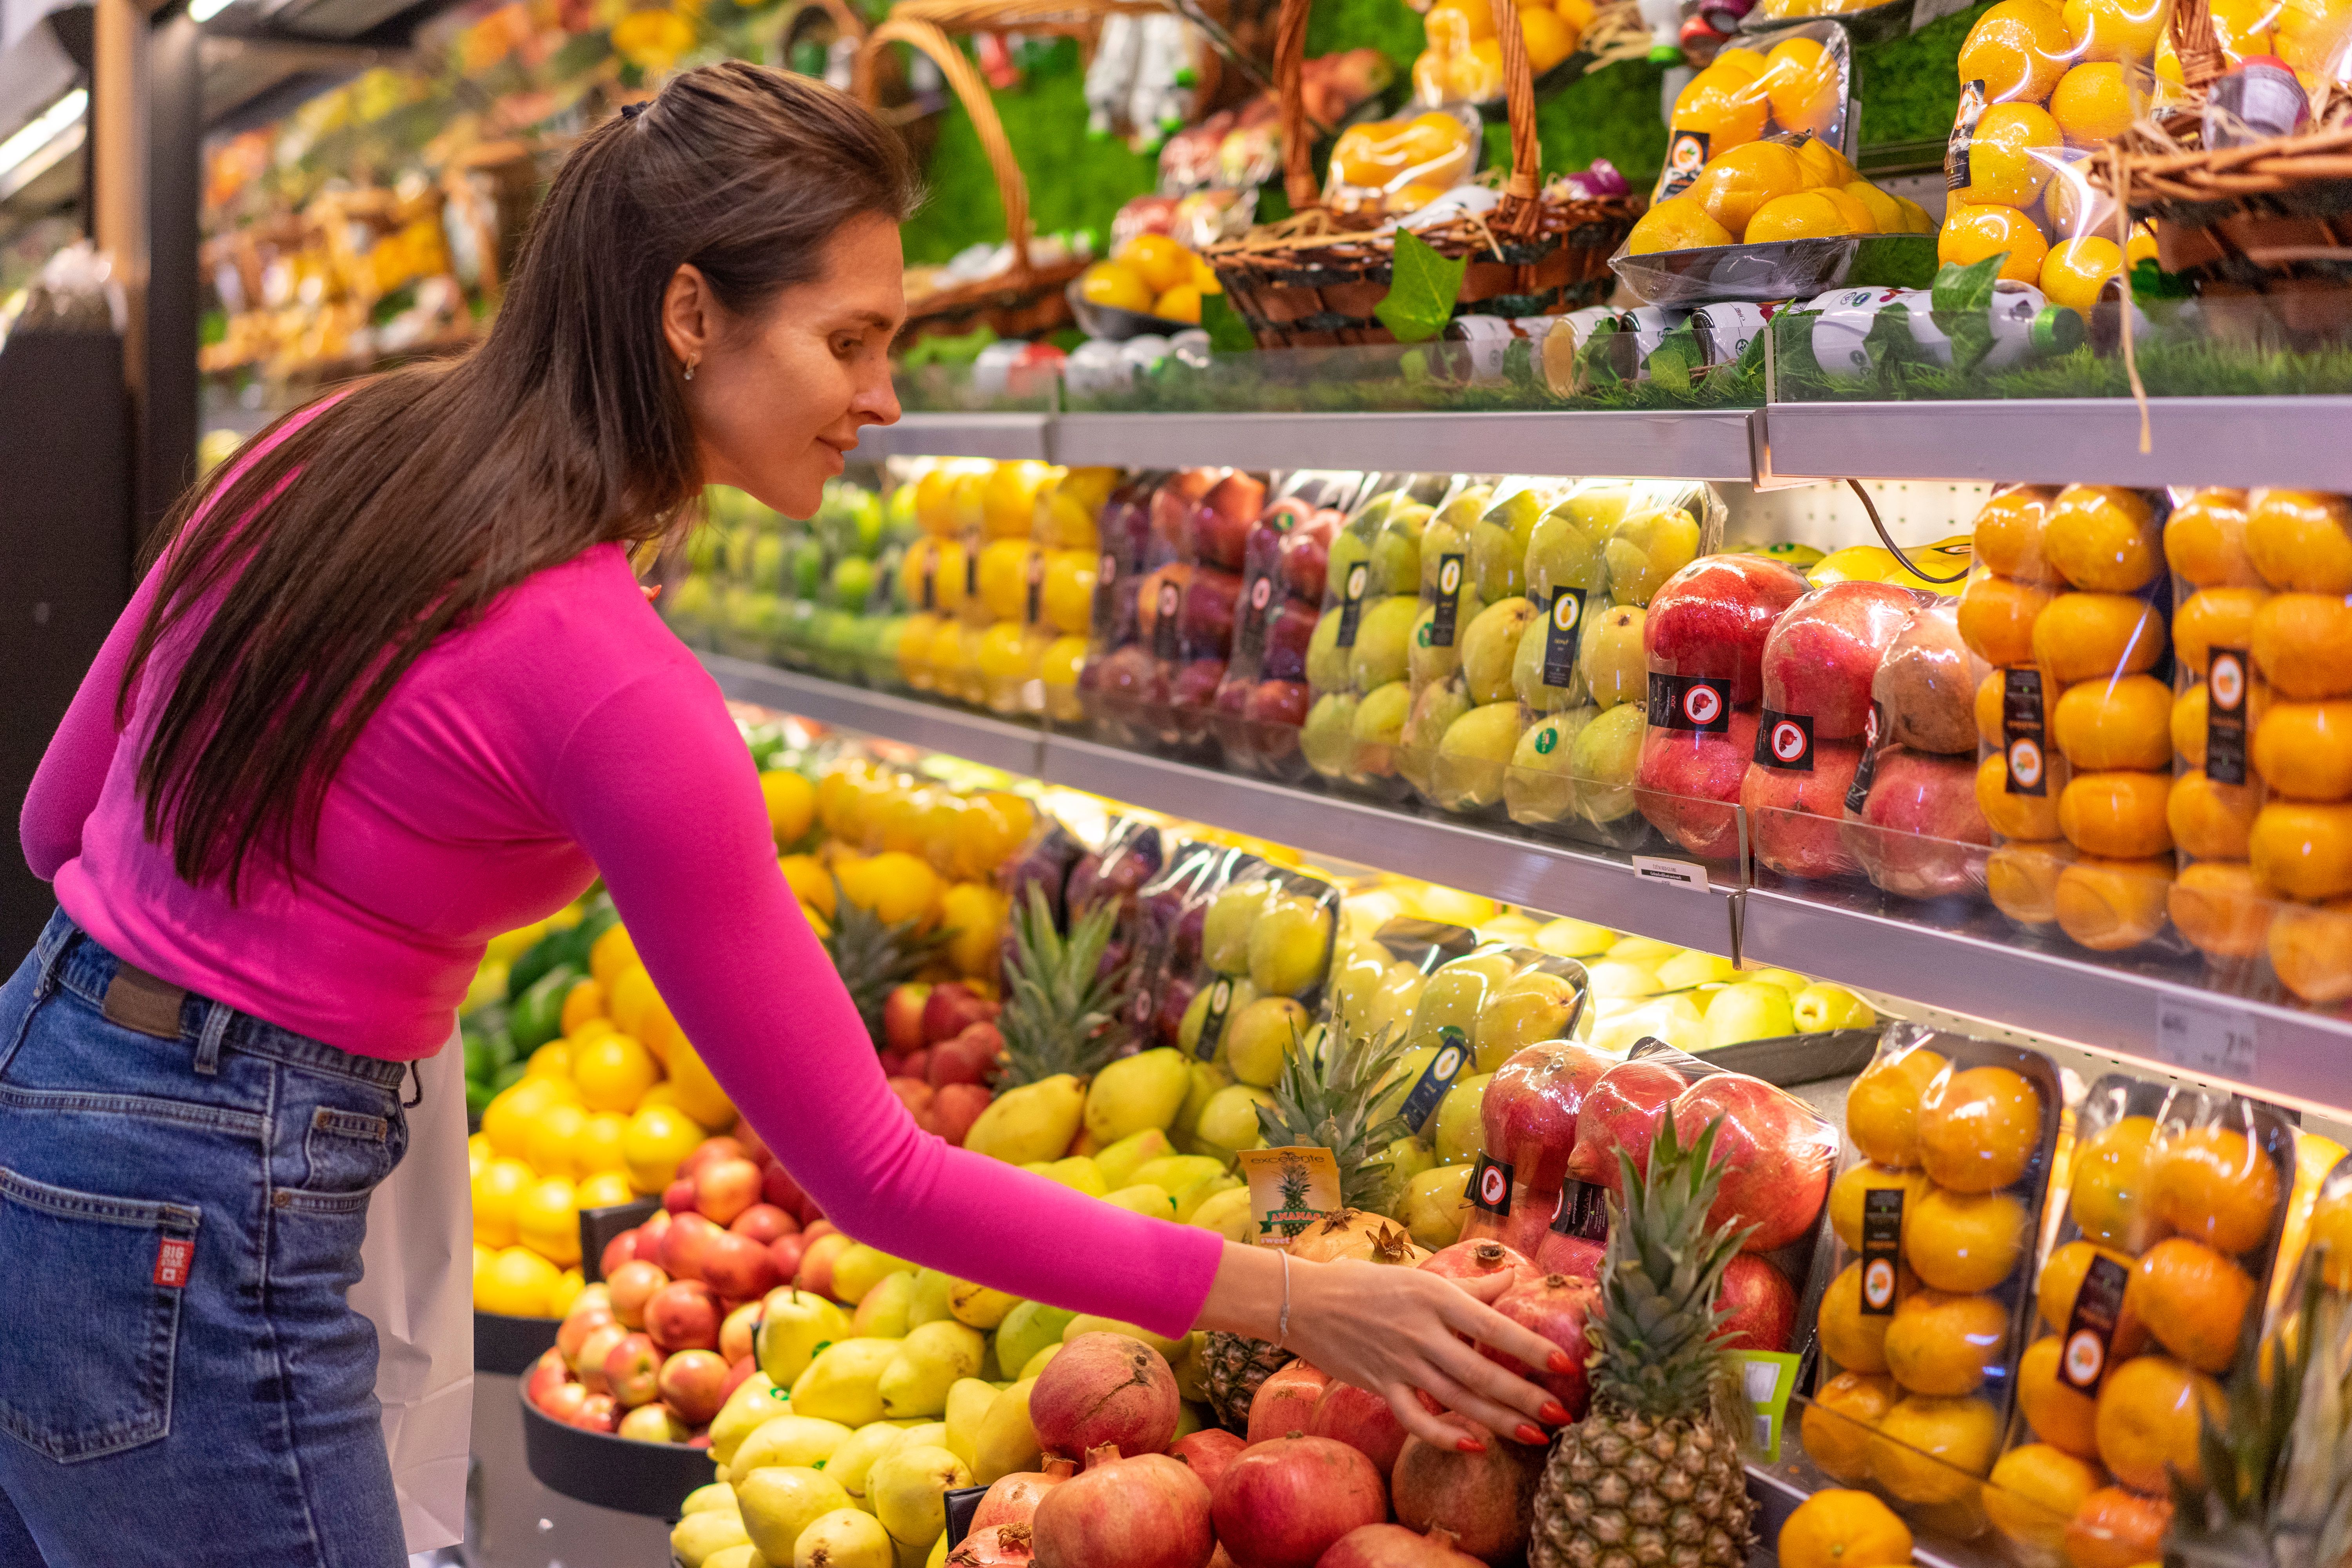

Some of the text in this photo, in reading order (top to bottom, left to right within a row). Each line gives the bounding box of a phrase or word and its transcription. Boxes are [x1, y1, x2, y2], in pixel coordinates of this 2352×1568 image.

[1251, 1154, 1325, 1164] excelente
[1271, 1211, 1321, 1223] ANANAS
[1261, 1236, 1290, 1245] sweet
